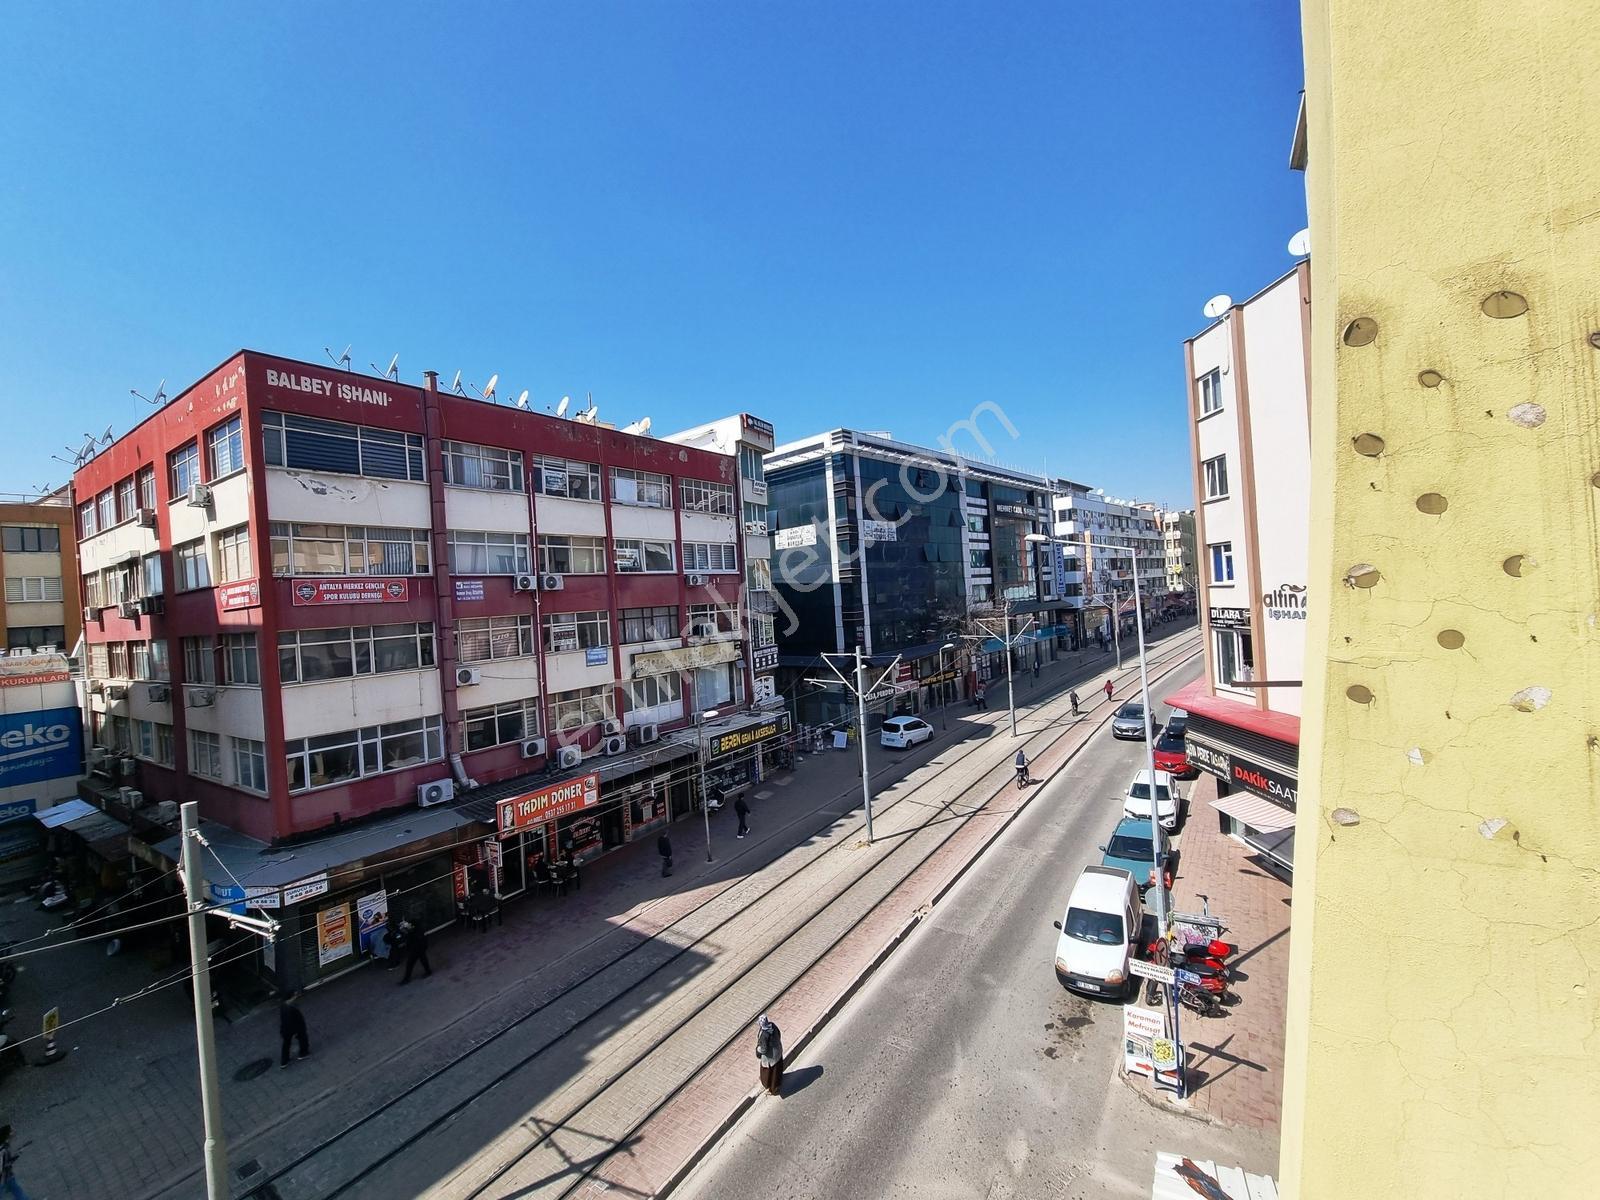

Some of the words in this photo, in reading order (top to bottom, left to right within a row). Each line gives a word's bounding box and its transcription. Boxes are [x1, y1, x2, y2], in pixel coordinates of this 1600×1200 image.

[266, 369, 332, 396] BALBEY
[1211, 607, 1240, 619] DİLARA
[1, 674, 68, 686] KURUMLARI
[721, 732, 741, 751] BEREN
[518, 795, 548, 816] TADIM
[551, 783, 583, 805] DÖNER
[1127, 1011, 1161, 1025] Karaman
